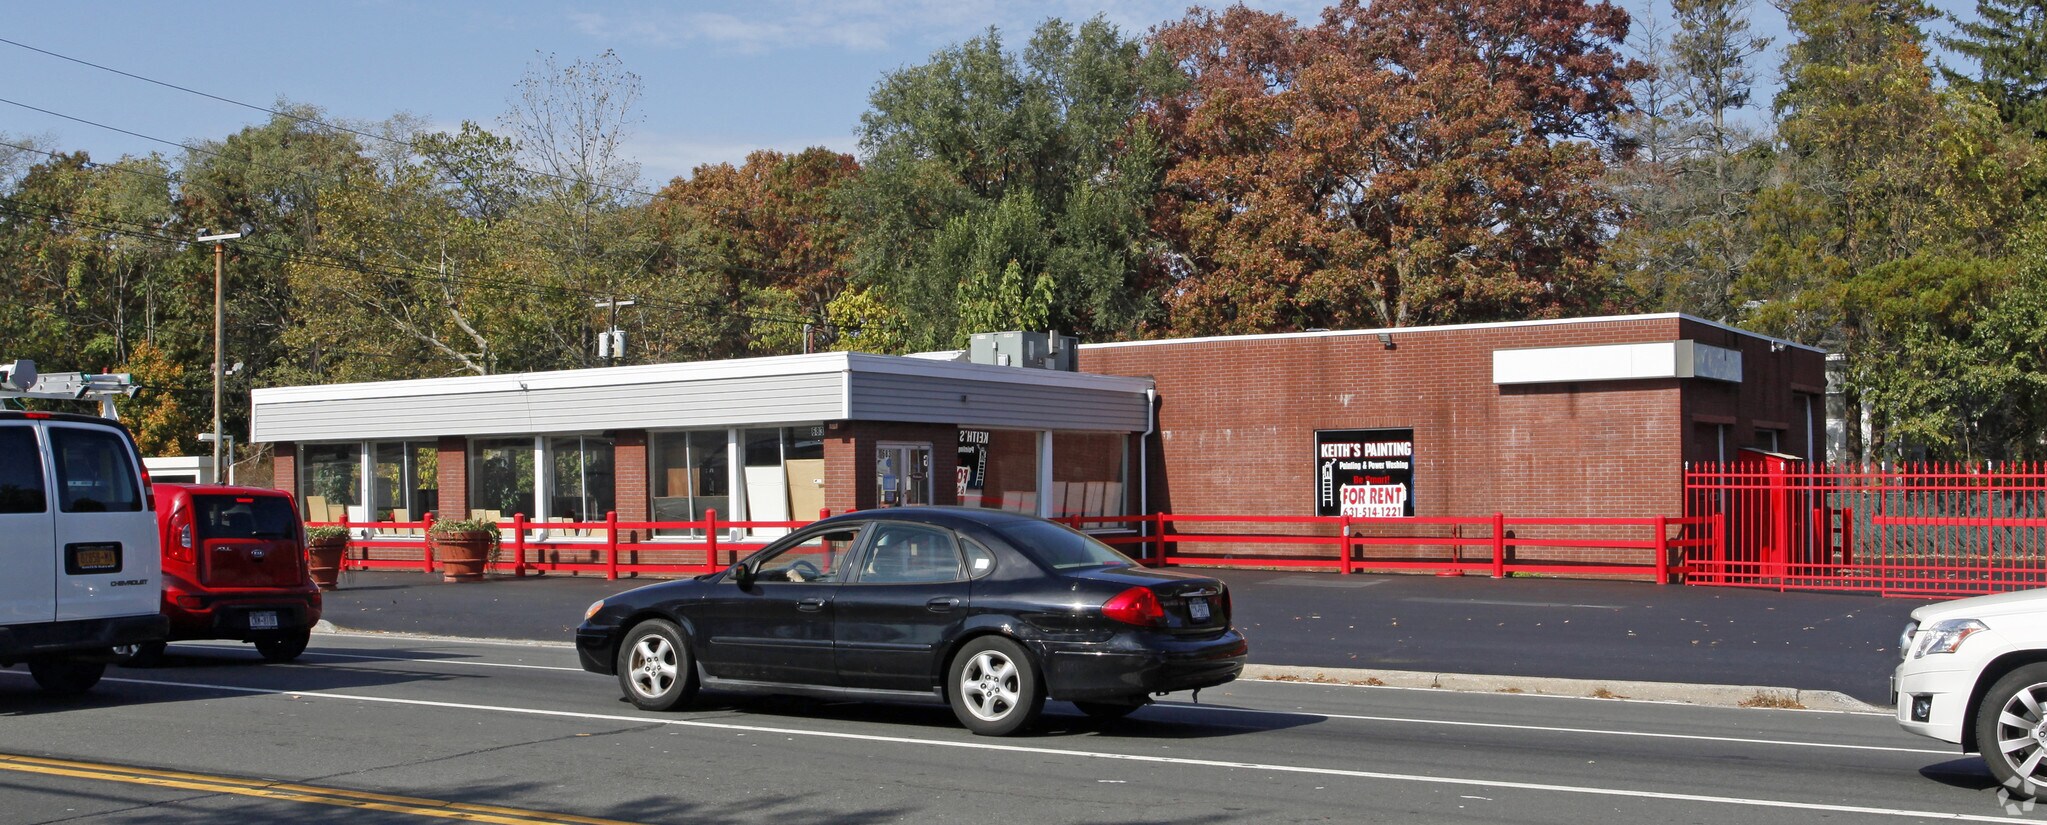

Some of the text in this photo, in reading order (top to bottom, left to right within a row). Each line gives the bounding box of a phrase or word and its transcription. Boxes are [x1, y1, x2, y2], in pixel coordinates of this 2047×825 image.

[1321, 441, 1412, 457] KEITH'S PAINTING
[1339, 461, 1408, 470] Painting & Power Washing
[1353, 475, 1363, 484] Be
[1343, 486, 1402, 505] FOR RENT
[1343, 507, 1401, 517] 631-514-1221
[110, 579, 148, 587] CHEVROLET
